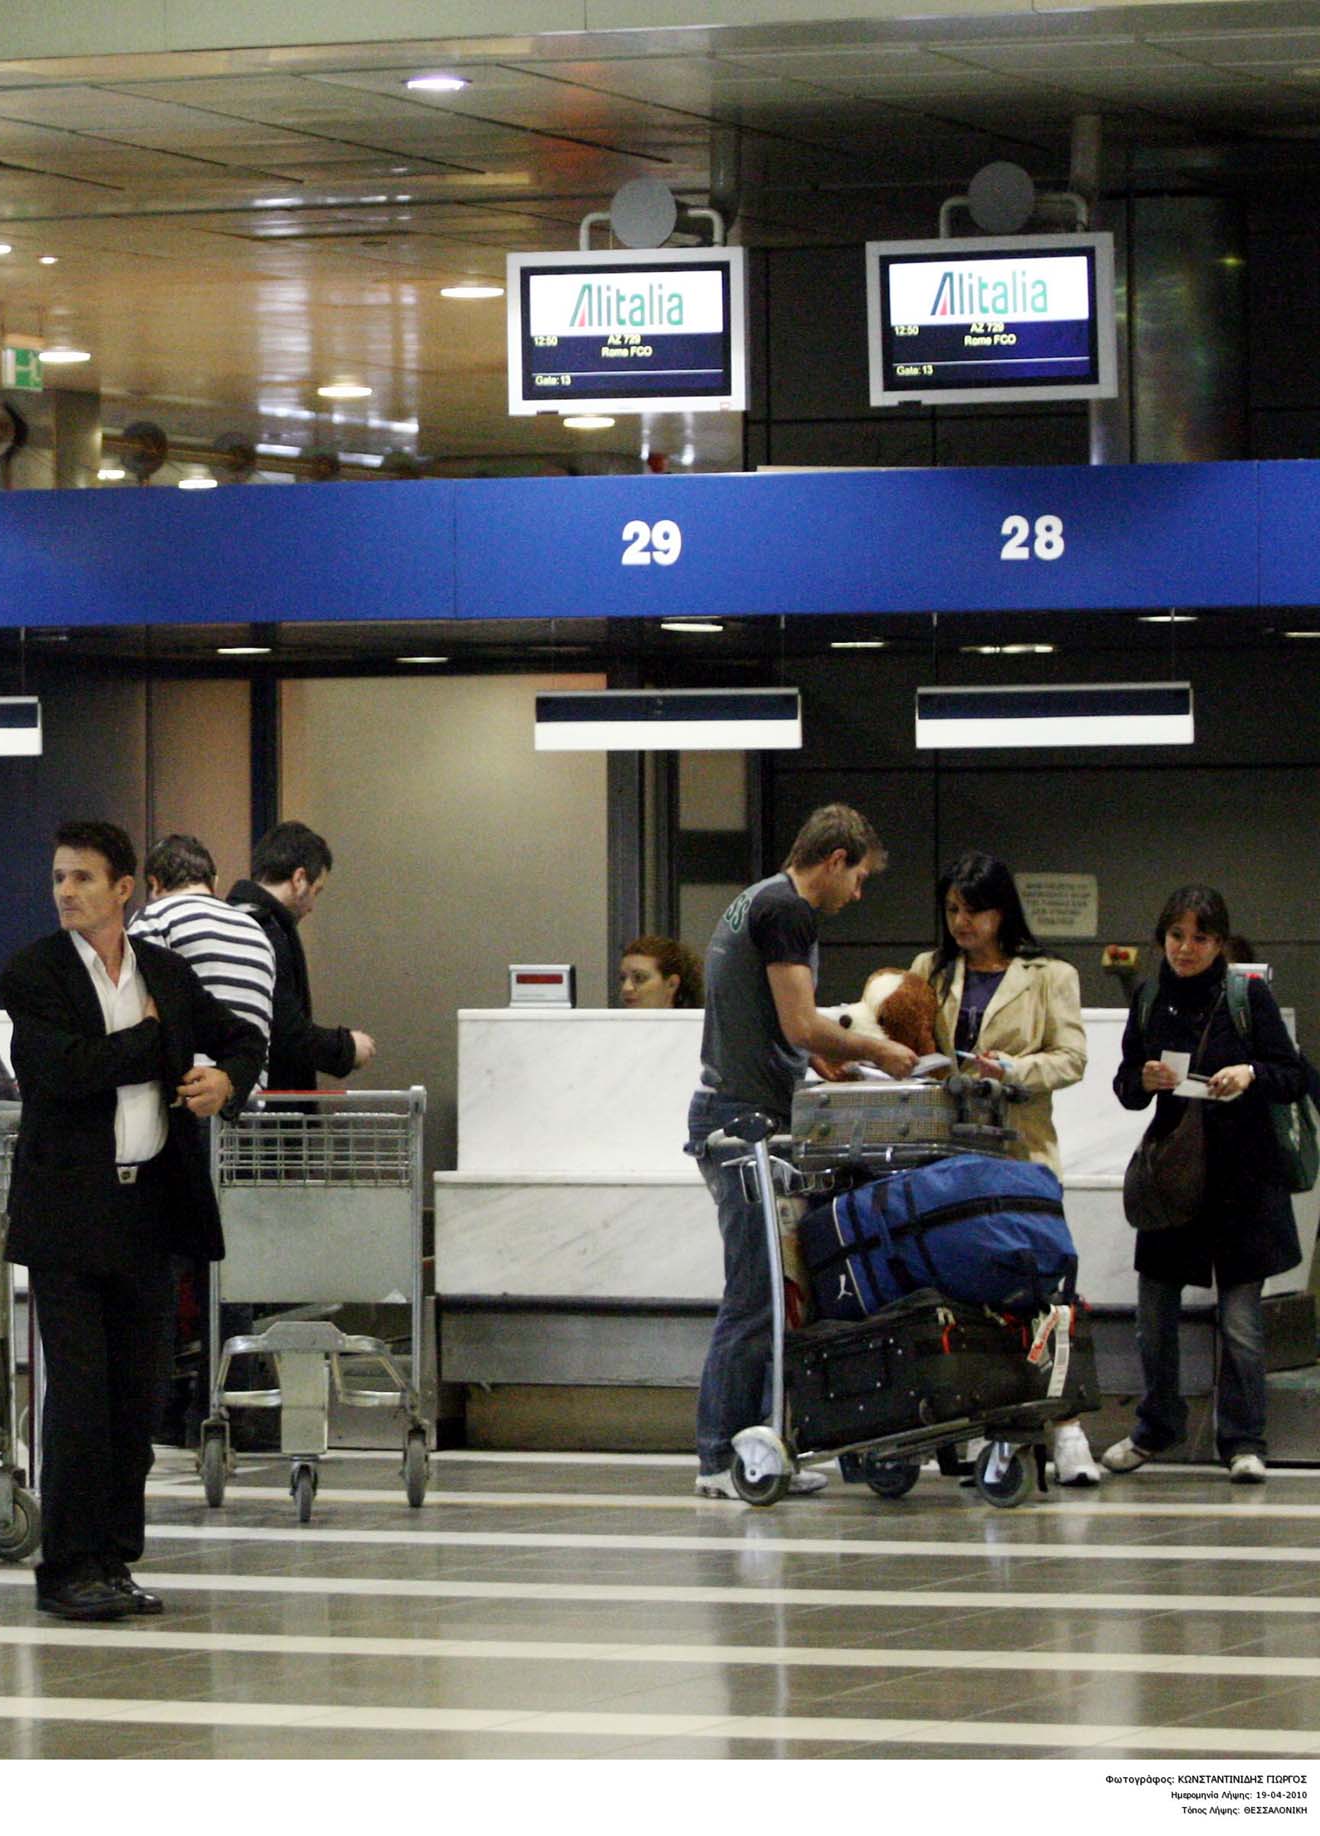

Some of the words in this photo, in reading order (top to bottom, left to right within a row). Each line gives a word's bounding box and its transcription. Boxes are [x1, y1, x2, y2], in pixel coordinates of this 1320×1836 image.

[930, 271, 1048, 316] Alitalia
[569, 283, 684, 328] Alitalia
[894, 325, 919, 336] 12:50
[970, 322, 985, 333] AZ
[607, 334, 623, 345] AZ
[964, 335, 992, 347] Rome
[994, 334, 1017, 345] FCO
[601, 347, 629, 358] Rome
[630, 346, 653, 357] FCO
[622, 519, 682, 566] 29
[1001, 514, 1065, 560] 28
